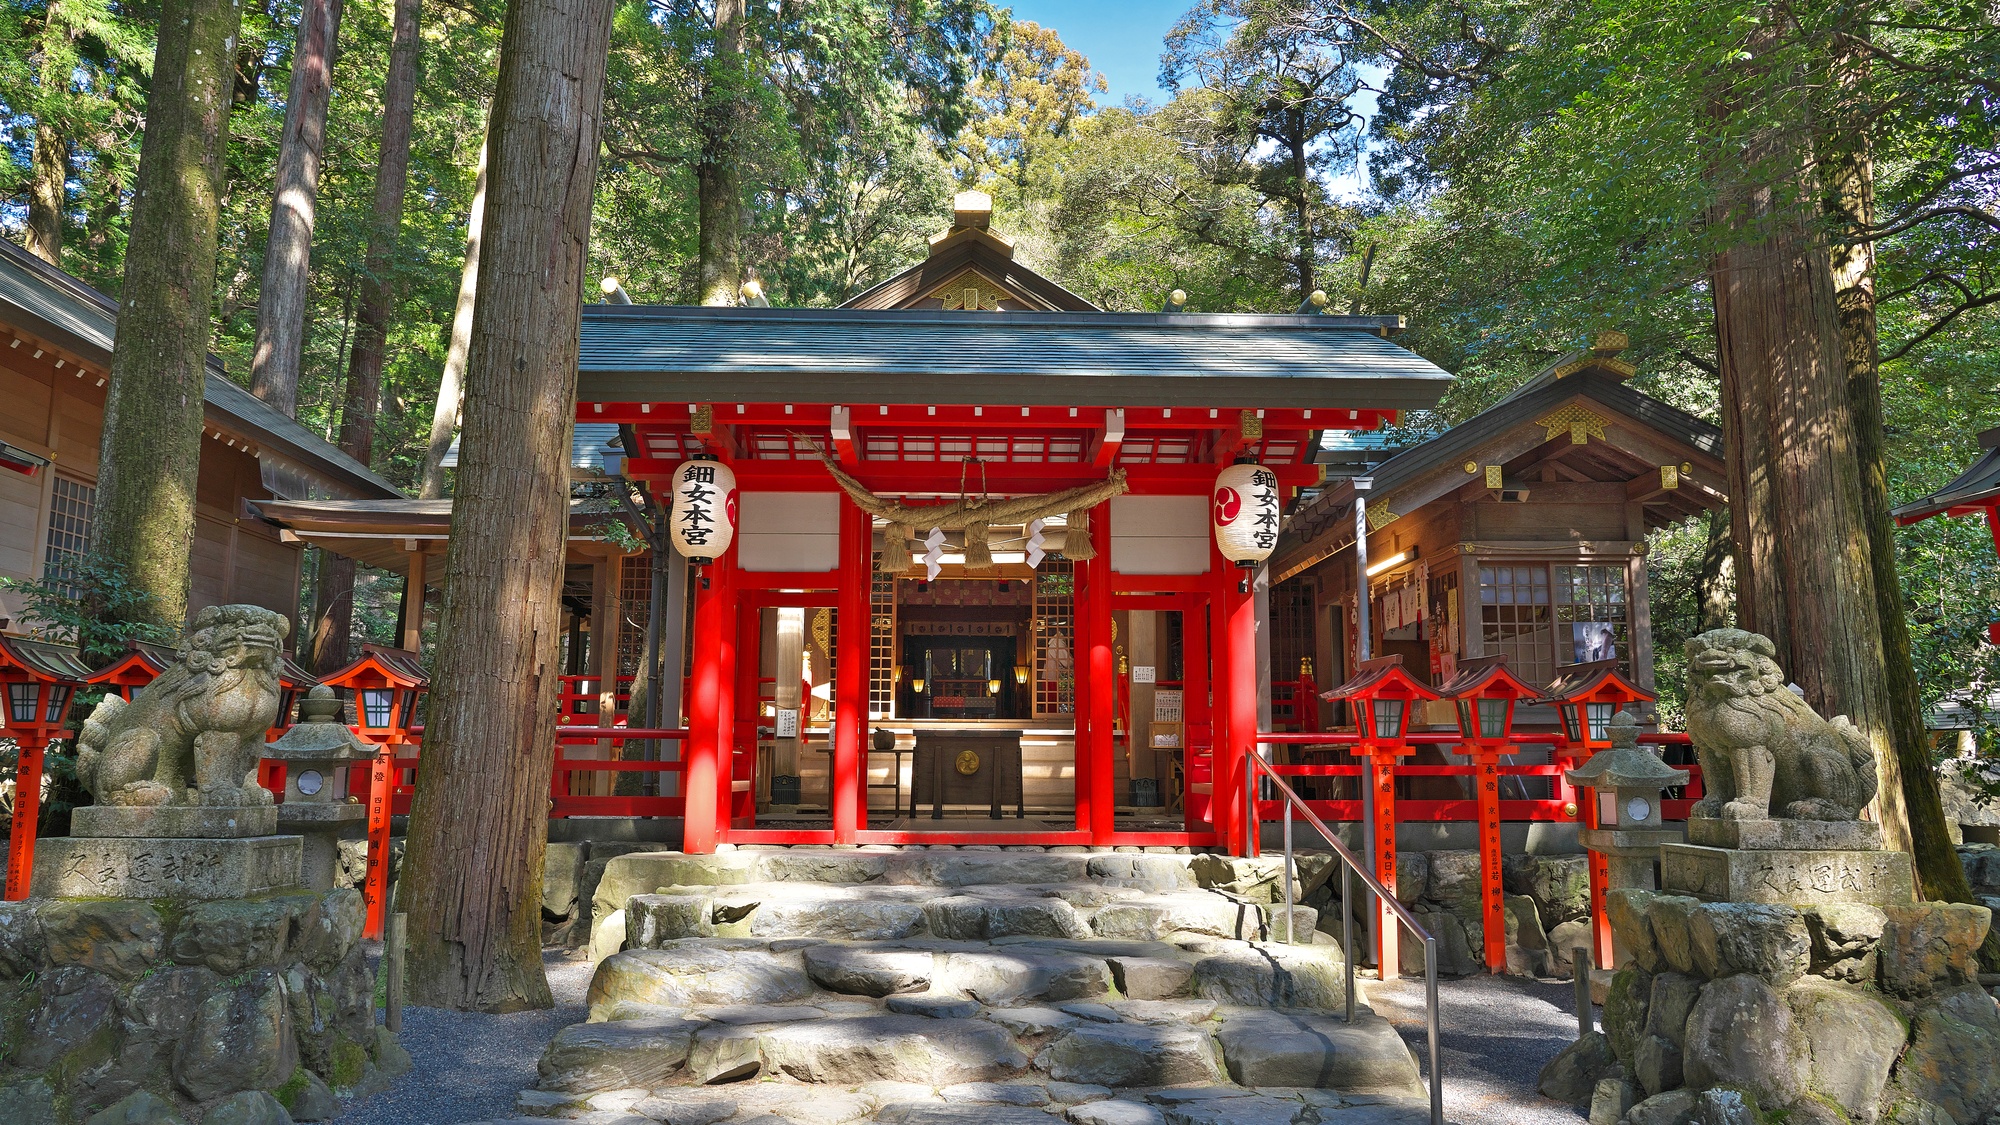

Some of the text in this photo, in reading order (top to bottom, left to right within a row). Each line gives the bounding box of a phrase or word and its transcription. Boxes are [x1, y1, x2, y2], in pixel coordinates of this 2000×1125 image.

[680, 464, 715, 545] 鈿女本宮
[1250, 469, 1278, 549] 鈿女本宮
[1381, 765, 1392, 793] 奉燈
[1485, 765, 1496, 792] 奉燈
[16, 791, 26, 829] 四日市市
[372, 796, 382, 835] 四日市市
[1383, 808, 1392, 845] 東京都
[1488, 806, 1497, 845] 京都市
